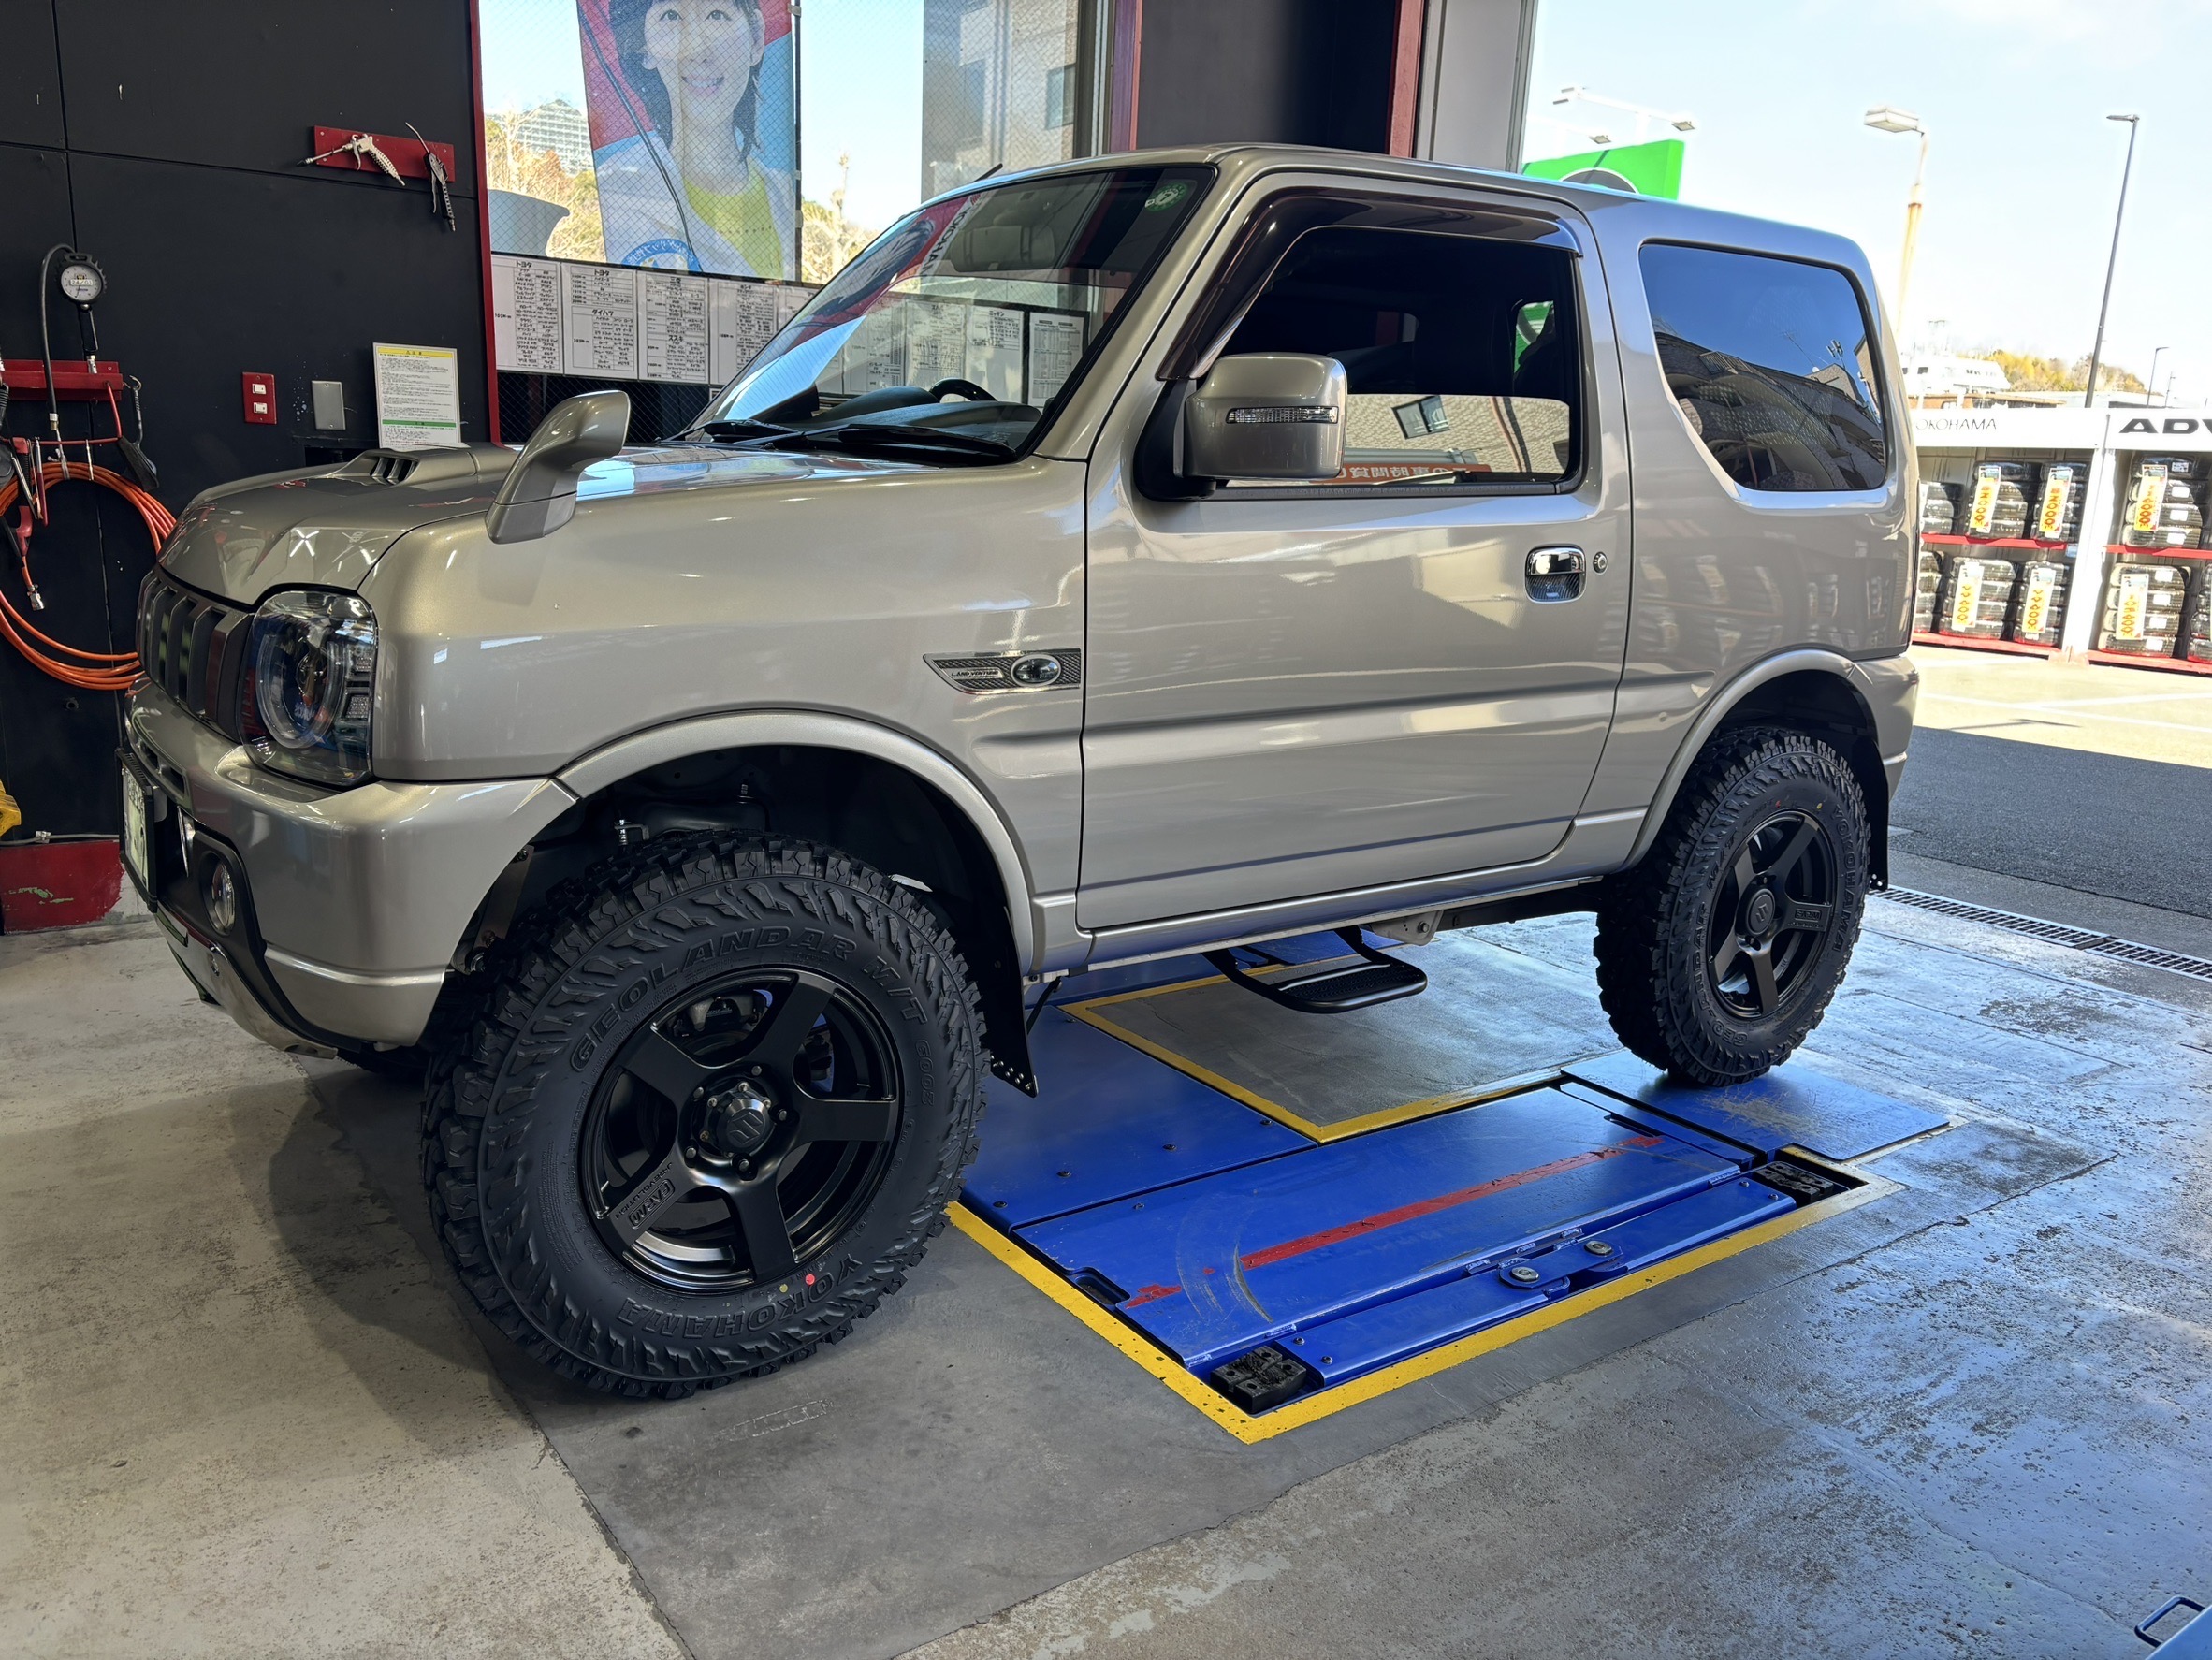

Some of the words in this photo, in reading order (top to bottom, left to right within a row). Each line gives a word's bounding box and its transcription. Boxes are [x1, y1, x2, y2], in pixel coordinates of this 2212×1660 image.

[1914, 418, 1997, 430] OKOHAMA
[1830, 804, 1858, 953] YOKOHAMA
[570, 925, 857, 1072] GEOLANDAR
[914, 1039, 935, 1107] G003
[632, 1182, 671, 1224] FARM
[615, 1252, 863, 1339] YOKOHAMA
